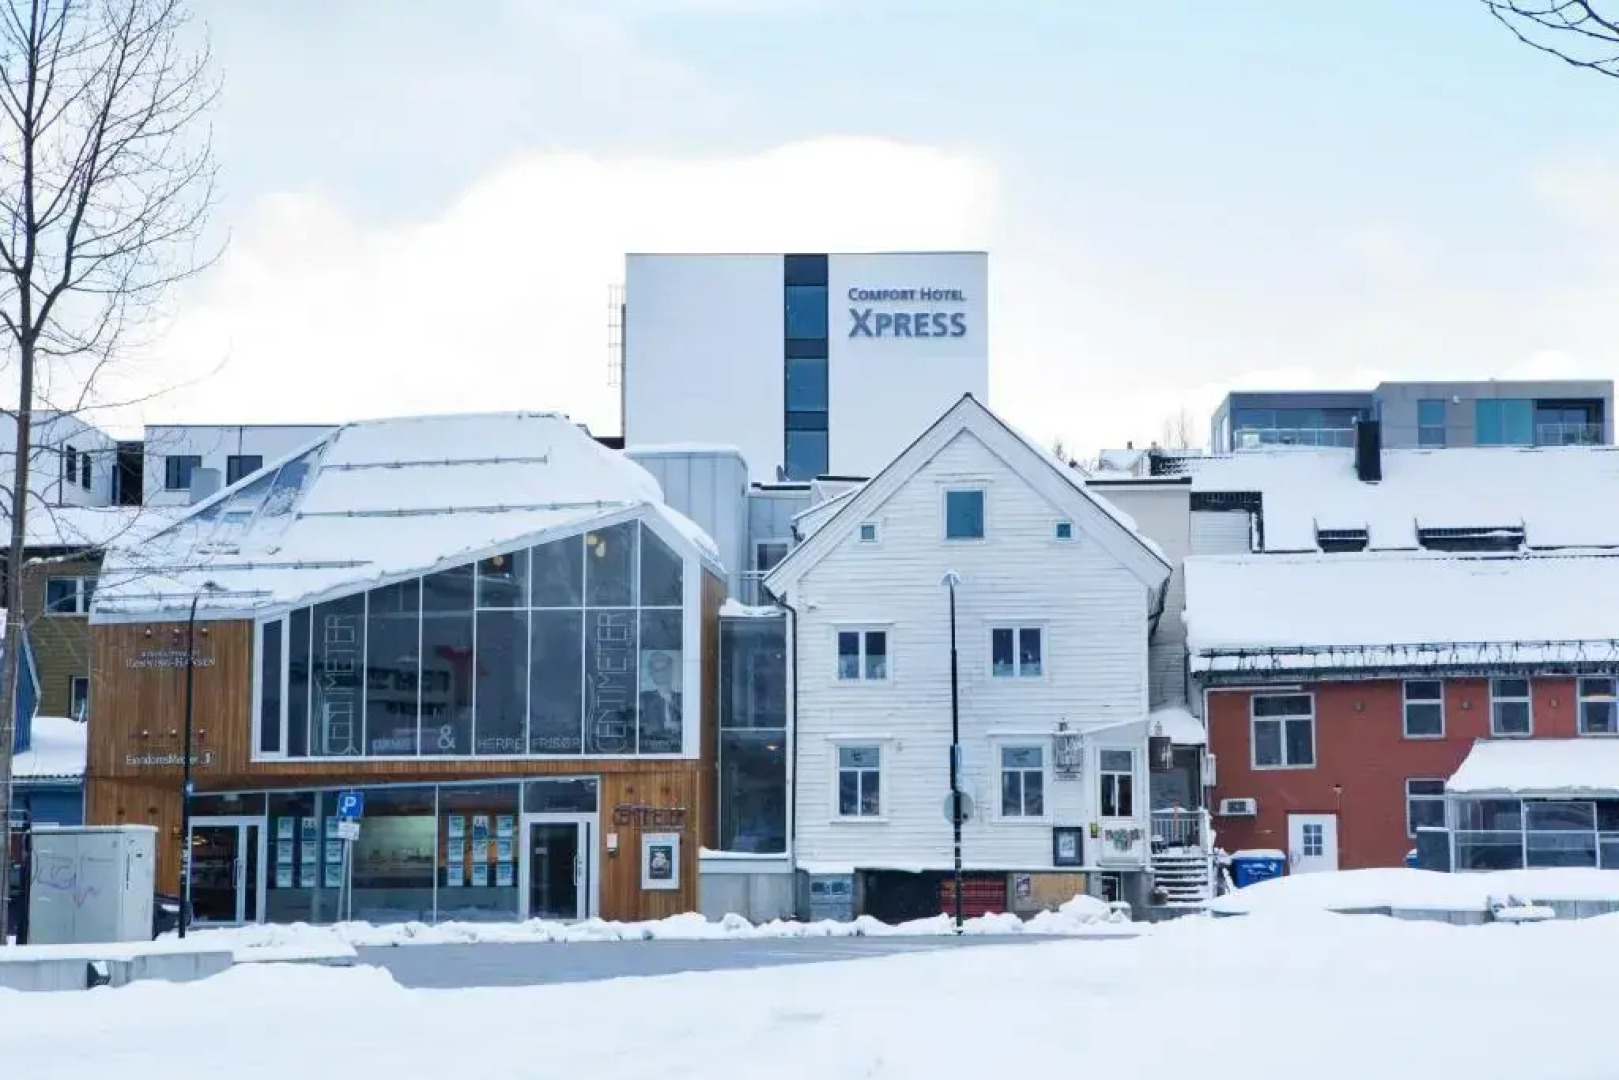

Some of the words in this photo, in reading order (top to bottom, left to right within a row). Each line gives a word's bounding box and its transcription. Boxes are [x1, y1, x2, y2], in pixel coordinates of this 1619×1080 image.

[848, 287, 917, 302] COMFORT
[921, 287, 966, 302] HOTEL
[848, 308, 967, 338] XPRESS
[597, 612, 627, 752] CENTIMETER
[345, 796, 357, 814] P
